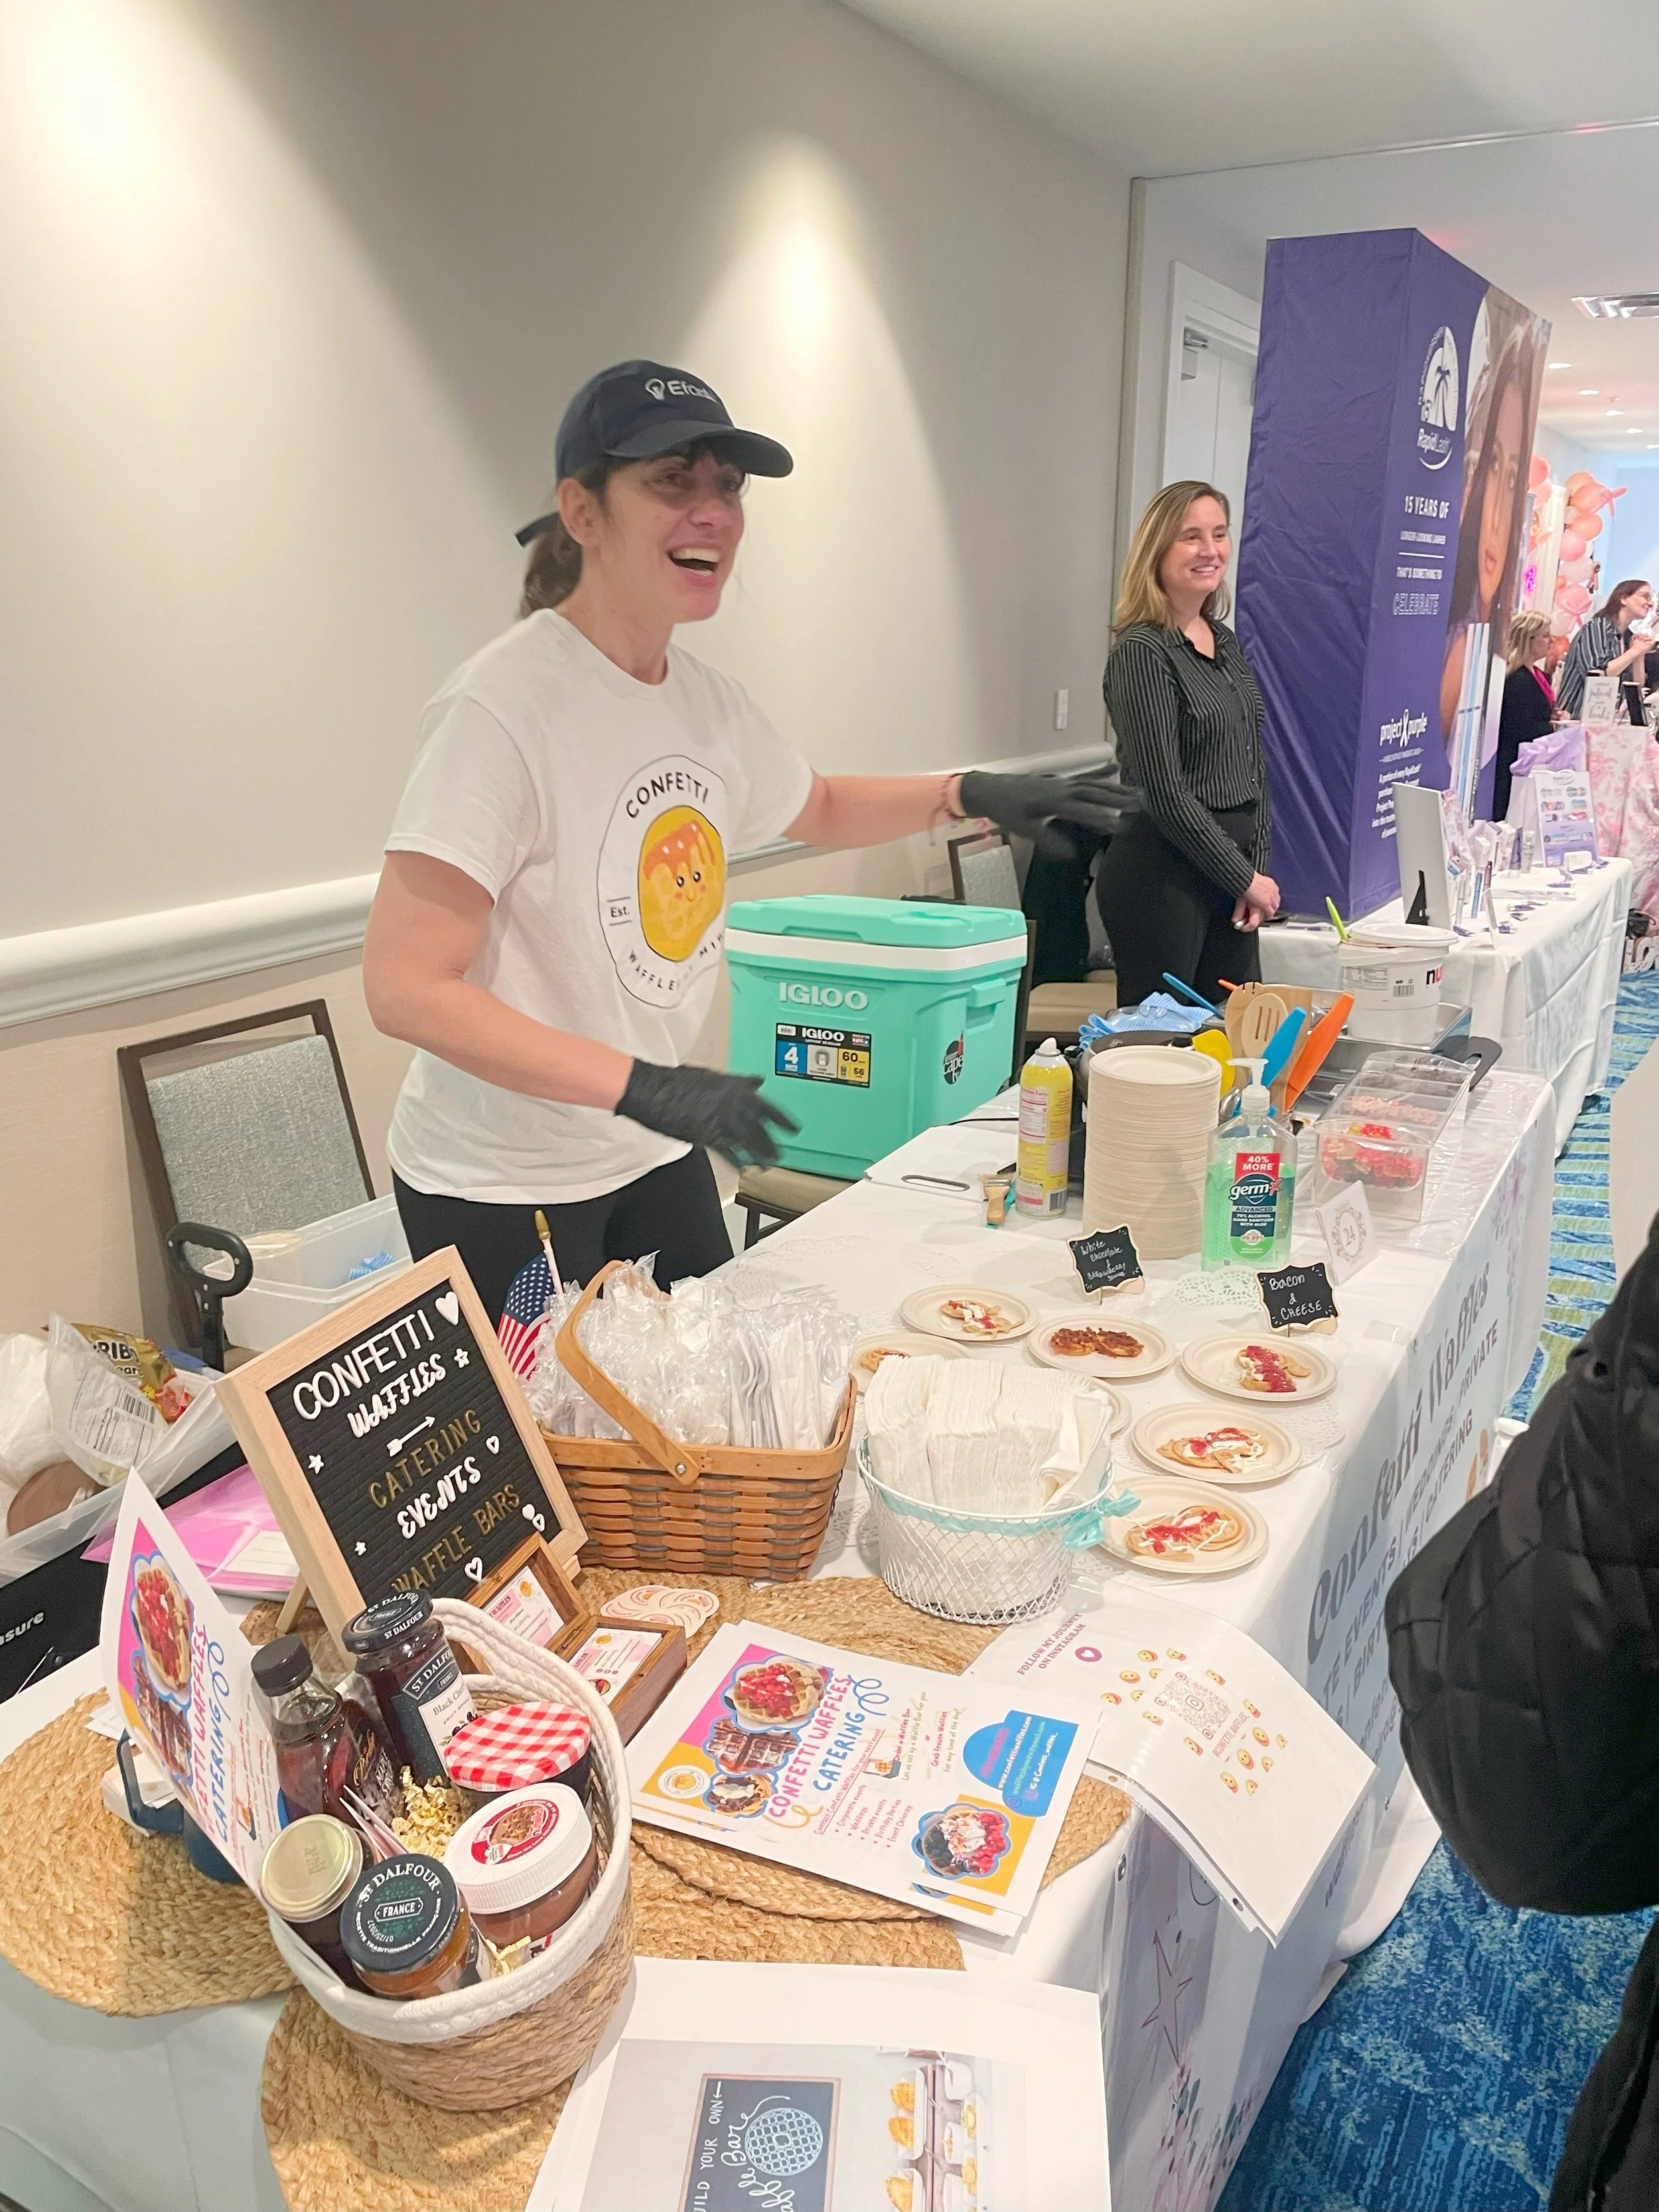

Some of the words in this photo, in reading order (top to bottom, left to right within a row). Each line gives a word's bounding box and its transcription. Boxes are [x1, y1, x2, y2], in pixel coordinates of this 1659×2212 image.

[1405, 495, 1413, 513] 15
[1414, 496, 1438, 517] YEARS
[1439, 500, 1450, 519] OF
[1394, 593, 1439, 615] CELEBRATE
[626, 772, 709, 818] CONFETTI
[610, 906, 630, 919] Est.
[778, 982, 868, 1010] IGLOO
[802, 1027, 845, 1042] IGLOO
[784, 1047, 798, 1065] 4
[842, 1052, 858, 1062] 60
[1080, 1240, 1106, 1256] White
[1342, 1227, 1356, 1246] 24
[1269, 1274, 1305, 1291] Bacon
[1280, 1299, 1322, 1321] CHEESE
[1289, 1292, 1297, 1305] &
[293, 1309, 435, 1421] CONFETTI
[346, 1353, 447, 1439] WAFFLES
[368, 1408, 482, 1509] CATERING
[1307, 1388, 1422, 1665] Confetti
[1429, 1262, 1489, 1424] Waffles
[1426, 1408, 1473, 1524] CATERING
[397, 1455, 482, 1540] EVENTS
[1344, 1535, 1397, 1667] EVENTS
[1459, 1318, 1498, 1399] PRIVATE
[390, 1524, 472, 1594] WAFFLE
[472, 1483, 521, 1535] BARS
[384, 1631, 393, 1640] ST
[393, 1611, 423, 1636] DALFOUR
[1017, 1647, 1045, 1675] FOLLOW
[1041, 1637, 1056, 1649] MY
[1052, 1612, 1082, 1639] JOURNEY
[1038, 1657, 1052, 1669] ON
[1048, 1623, 1087, 1659] INSTAGRAM
[192, 1625, 208, 1742] WAFFLES
[411, 1677, 424, 1692] ST
[433, 1697, 453, 1716] Black
[914, 1712, 922, 1722] Bar
[910, 1722, 920, 1741] Waffle
[938, 1711, 948, 1732] Waffles
[768, 1743, 820, 1818] CONFETTI
[808, 1677, 853, 1739] WAFFLES
[813, 1712, 865, 1791] CATERING
[893, 1745, 903, 1761] Order
[898, 1719, 908, 1740] Waffles
[934, 1733, 942, 1752] Frozen
[209, 1696, 228, 1843] CATERING
[931, 1752, 940, 1767] Grab
[947, 1753, 956, 1762] any
[901, 1771, 910, 1781] Let
[837, 1800, 857, 1826] Corporate
[854, 1784, 867, 1801] events
[861, 1816, 877, 1834] Private
[875, 1799, 887, 1817] events
[850, 1806, 869, 1830] Weddings
[875, 1816, 893, 1838] Birthday
[887, 1825, 901, 1842] Event
[895, 1805, 914, 1828] Catering
[358, 1883, 374, 1903] ST
[372, 1862, 442, 1891] DALFOUR
[382, 1902, 416, 1918] FRANCE
[708, 2099, 725, 2124] OWN
[700, 2137, 719, 2171] YOUR
